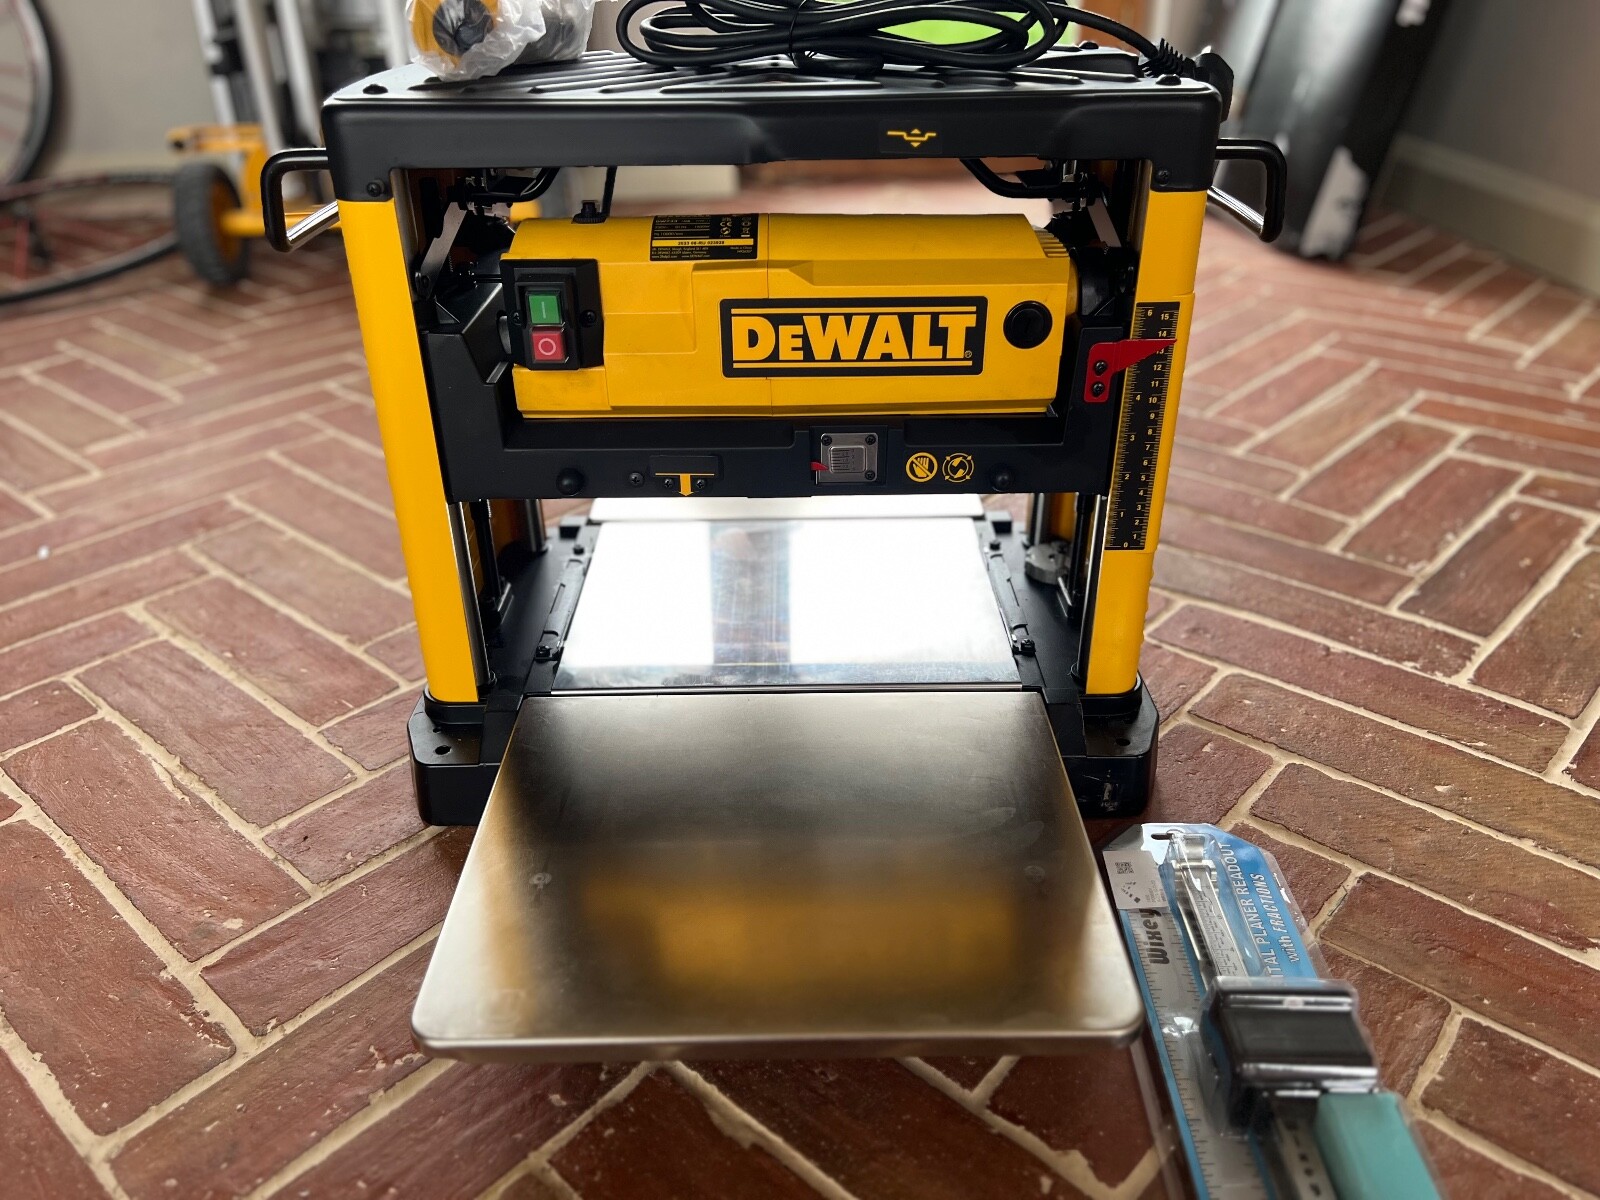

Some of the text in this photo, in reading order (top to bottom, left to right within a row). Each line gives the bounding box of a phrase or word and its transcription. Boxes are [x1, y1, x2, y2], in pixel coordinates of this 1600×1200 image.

[1147, 309, 1153, 317] 6
[731, 314, 976, 362] DEWALT
[1158, 330, 1167, 338] 14
[1151, 380, 1159, 388] 11
[1148, 396, 1158, 404] 10
[1149, 412, 1156, 420] 9
[1147, 428, 1153, 436] 8
[1219, 842, 1250, 895] READOUT
[1240, 898, 1271, 945] PLANER
[1249, 873, 1300, 963] with FRACTIONS
